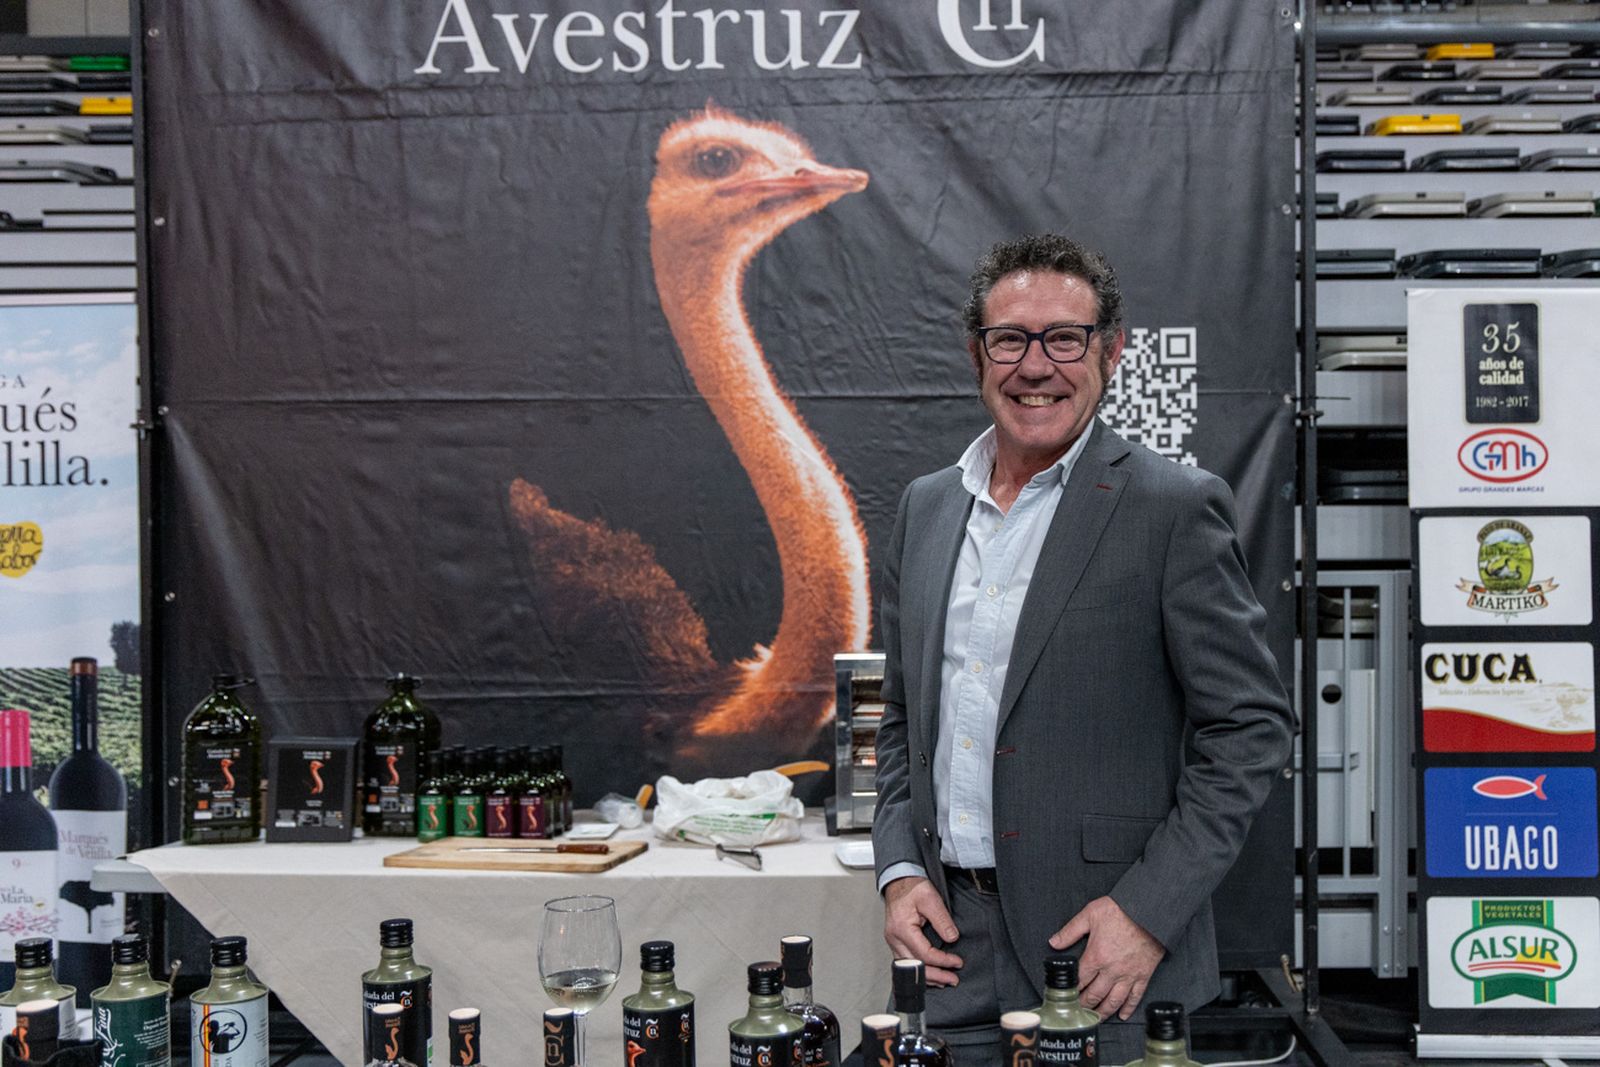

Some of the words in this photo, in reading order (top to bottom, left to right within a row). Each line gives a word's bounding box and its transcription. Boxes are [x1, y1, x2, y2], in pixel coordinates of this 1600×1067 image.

[415, 0, 863, 75] Avestruz
[1482, 322, 1521, 354] 35
[1478, 357, 1507, 371] años
[1509, 356, 1525, 370] de
[1478, 371, 1525, 385] calidad
[1475, 396, 1497, 409] 1982
[1506, 396, 1530, 409] 2017
[2, 440, 109, 487] lilla.
[1472, 593, 1546, 611] MARTIKO
[1464, 825, 1559, 871] UBAGO
[1484, 904, 1542, 912] PRODUCTOS
[1469, 935, 1560, 962] ALSUR
[1067, 1038, 1082, 1049] del
